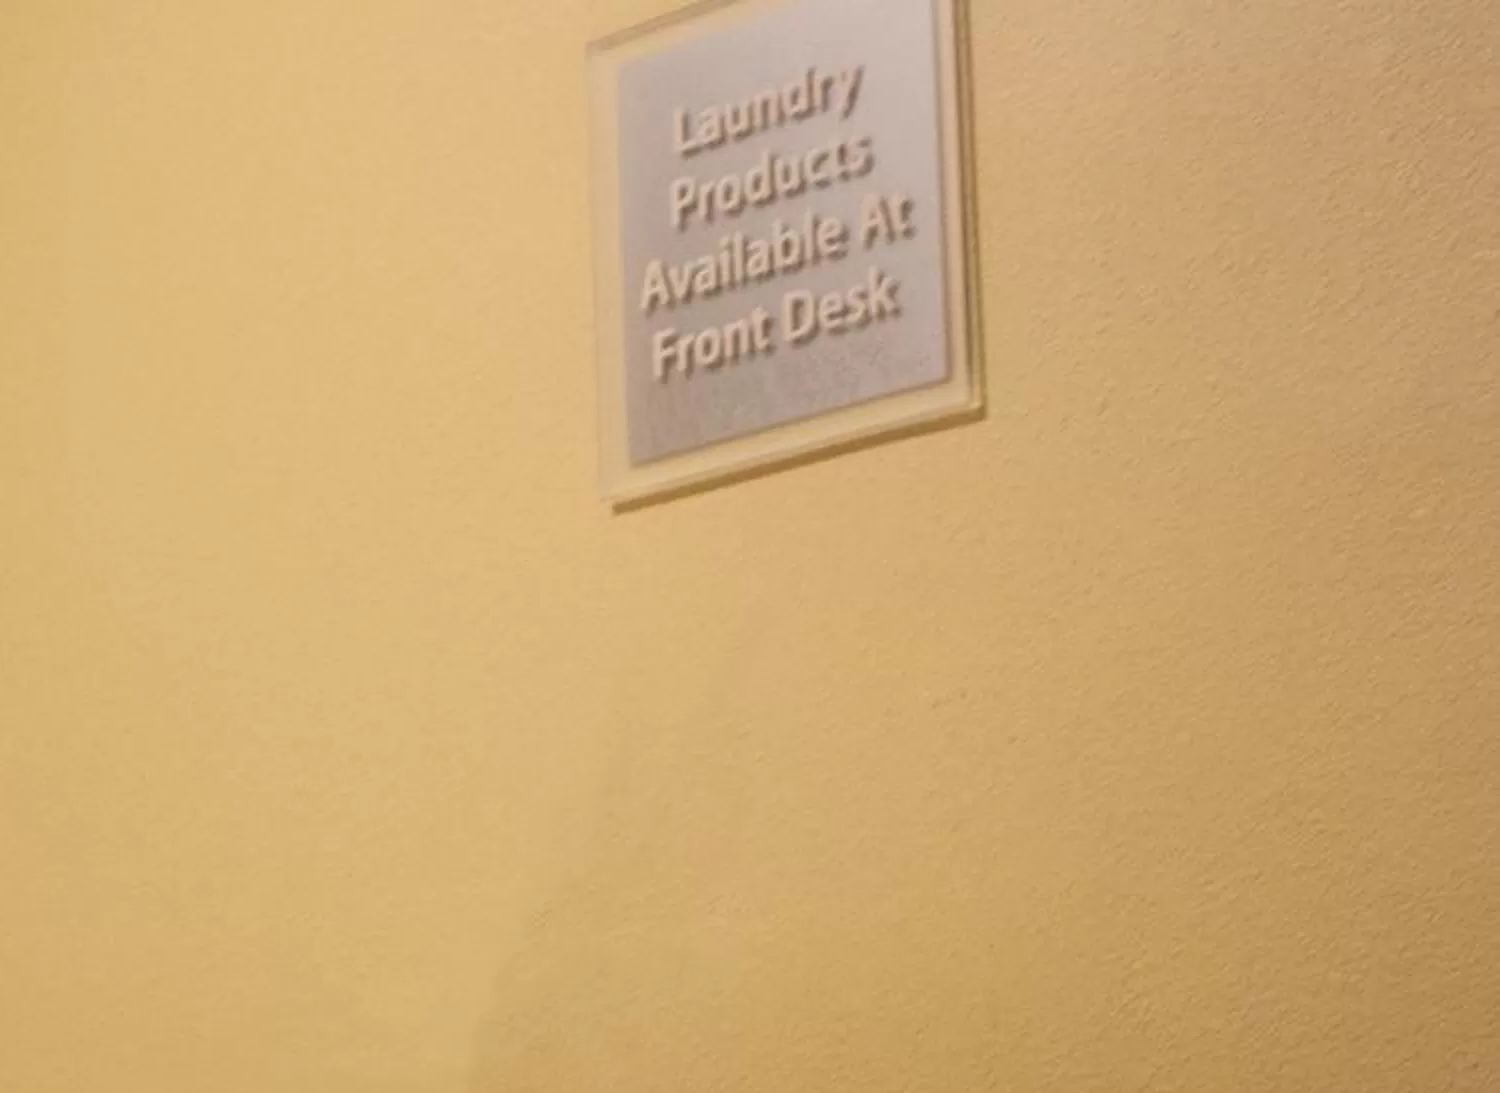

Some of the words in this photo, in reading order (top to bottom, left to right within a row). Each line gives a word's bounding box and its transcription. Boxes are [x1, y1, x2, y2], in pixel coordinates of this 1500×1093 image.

[673, 64, 864, 157] Laundry
[670, 136, 874, 231] Products
[639, 212, 850, 315] Available
[861, 194, 916, 248] At
[652, 305, 773, 383] Front
[784, 267, 901, 344] Desk
